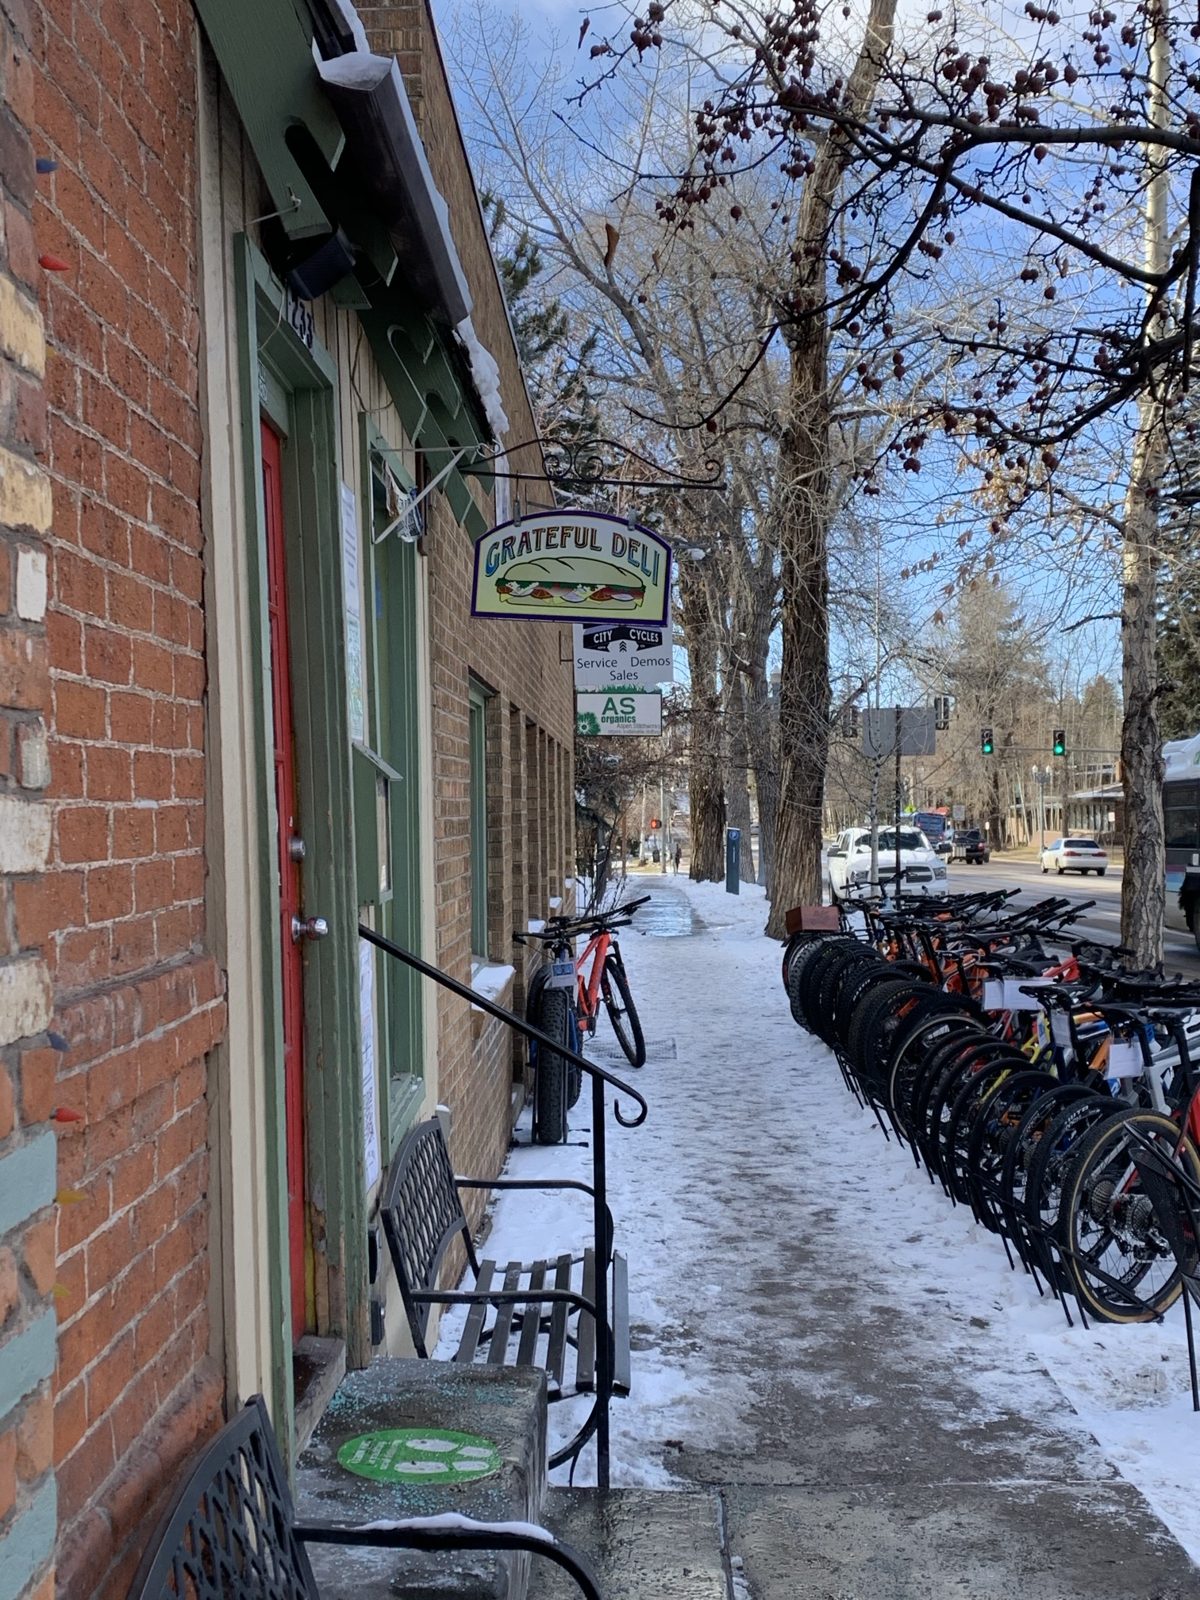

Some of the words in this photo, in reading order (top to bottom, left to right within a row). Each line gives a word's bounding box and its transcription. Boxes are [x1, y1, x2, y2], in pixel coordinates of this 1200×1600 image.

[485, 526, 602, 577] GRATEFUL
[611, 532, 660, 586] DELI
[593, 630, 613, 643] CITY
[629, 629, 659, 642] CYCLES
[577, 658, 618, 669] Service
[630, 656, 671, 667] Demos
[609, 670, 639, 681] Sales
[602, 697, 635, 715] AS
[601, 715, 636, 724] organics
